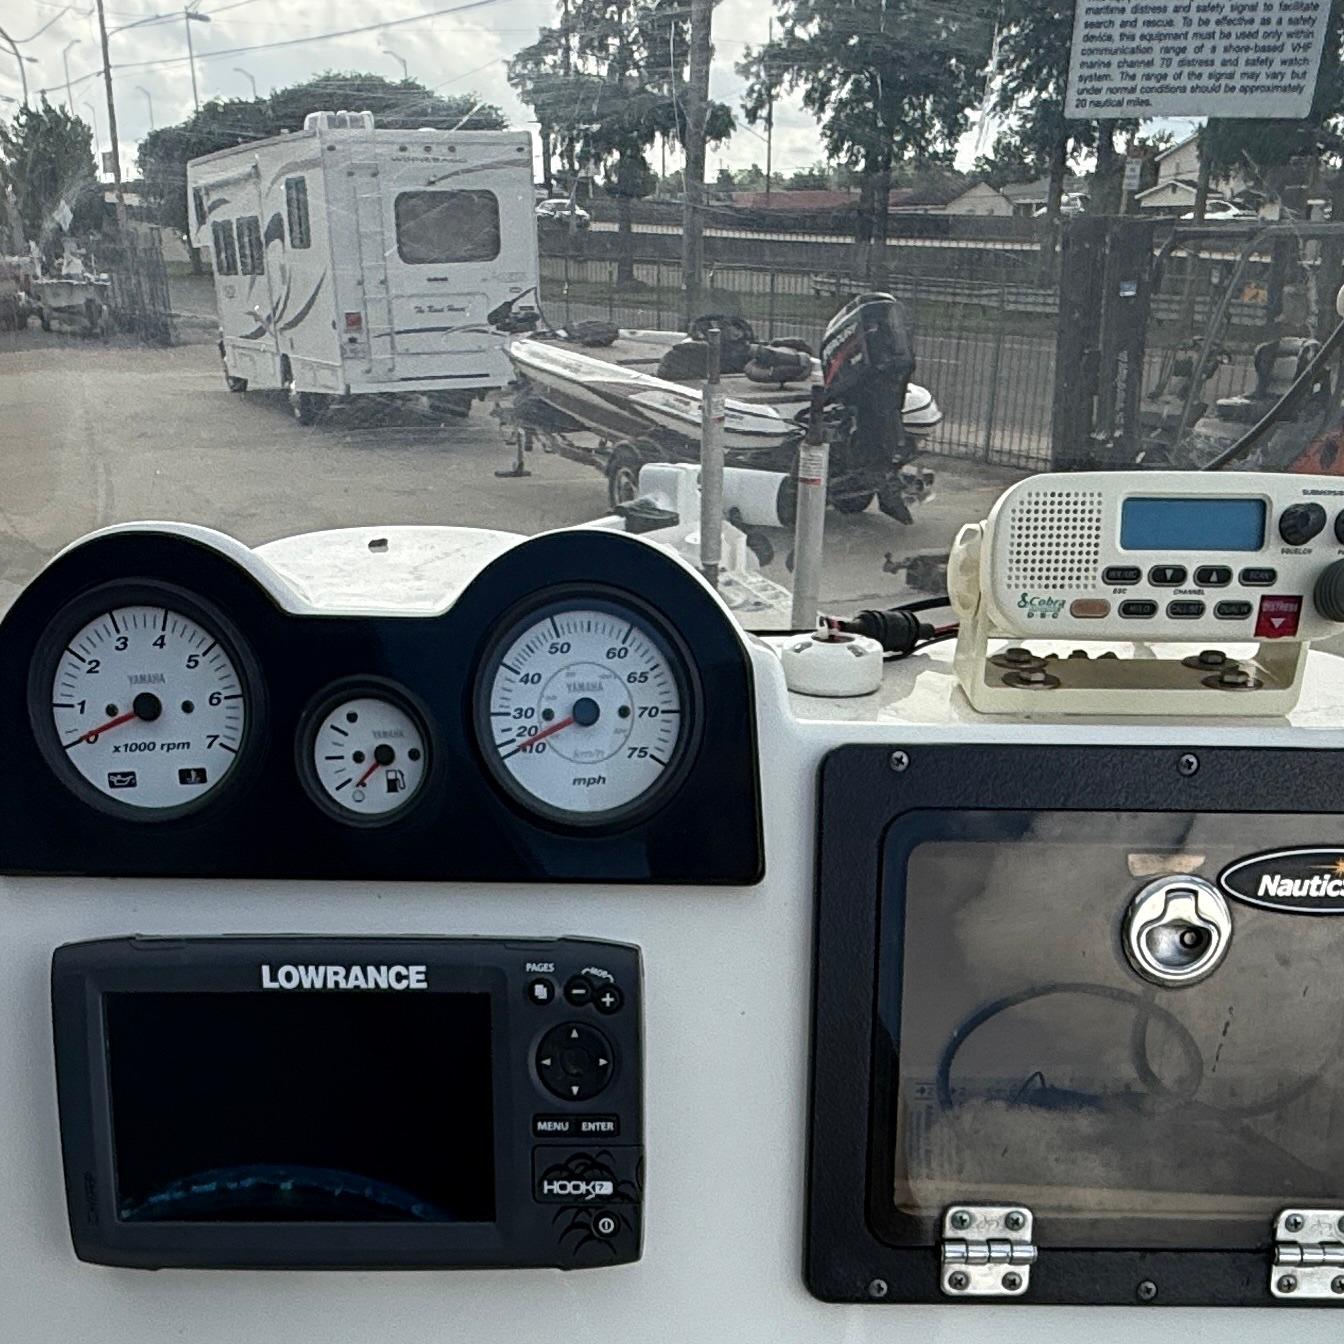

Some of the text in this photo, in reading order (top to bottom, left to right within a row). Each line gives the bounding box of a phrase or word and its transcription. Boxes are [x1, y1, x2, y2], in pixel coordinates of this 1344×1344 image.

[114, 636, 129, 652] 3
[152, 634, 167, 650] 4
[547, 641, 572, 655] 50
[605, 646, 629, 660] 60
[86, 659, 101, 674] 2
[185, 654, 201, 670] 5
[518, 671, 543, 685] 40
[626, 671, 650, 684] 65
[208, 692, 223, 706] 6
[76, 699, 87, 715] 1
[511, 706, 536, 720] 30
[637, 705, 660, 719] 70
[515, 725, 539, 738] 20
[112, 741, 191, 753] x1000 rpm
[205, 734, 220, 750] 7
[626, 746, 650, 759] 75
[572, 774, 607, 788] mph
[525, 962, 555, 974] PAGES
[261, 964, 429, 990] LOWRANCE
[537, 1121, 570, 1132] MENU
[581, 1121, 614, 1132] ENTER
[543, 1180, 595, 1200] HOOK
